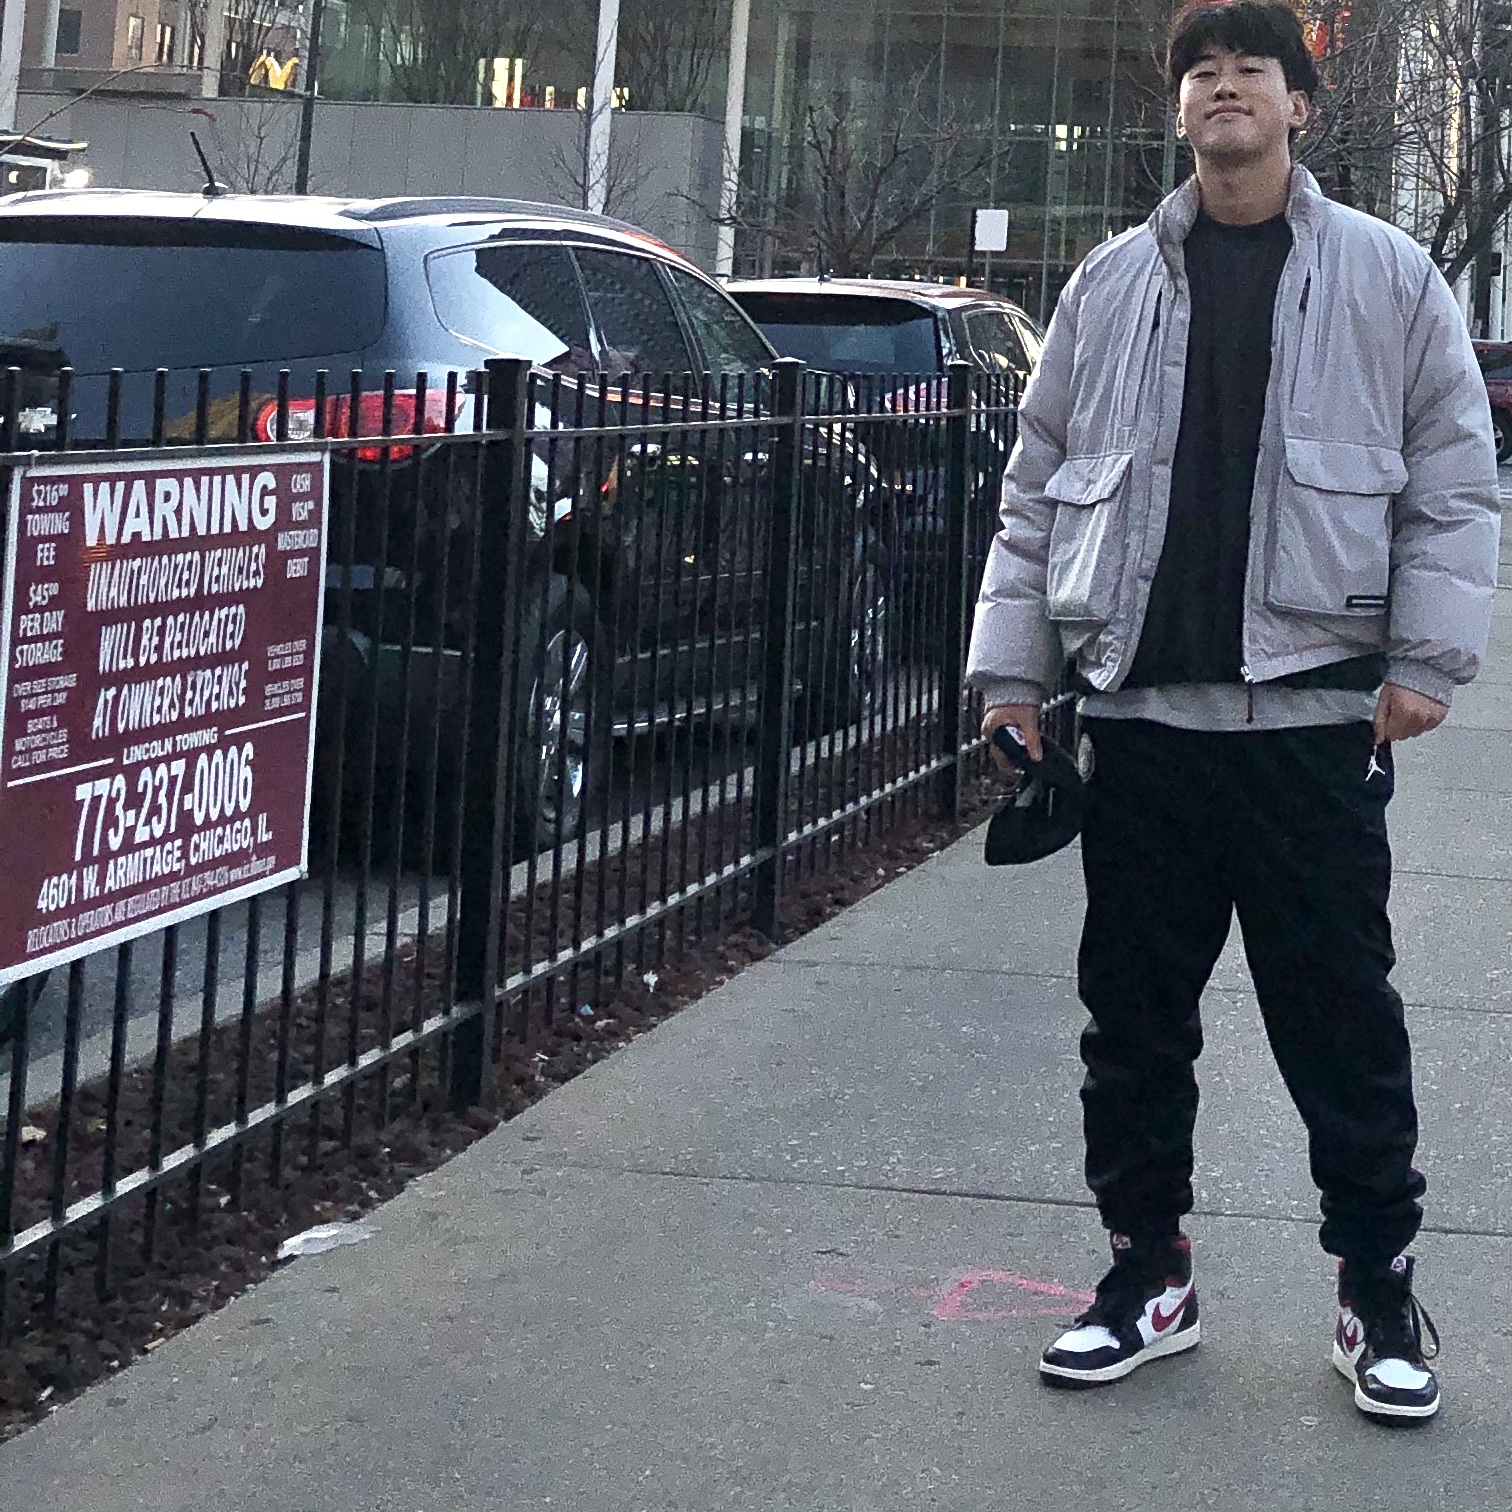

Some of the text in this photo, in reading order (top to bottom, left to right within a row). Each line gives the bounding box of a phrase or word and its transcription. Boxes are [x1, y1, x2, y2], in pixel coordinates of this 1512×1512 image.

[291, 472, 312, 493] CASH
[25, 511, 71, 537] TOWING
[83, 471, 277, 546] WARNING
[36, 542, 57, 566] FEE
[286, 557, 310, 579] DEBIT
[86, 543, 266, 613] UNAUTHORIZED VEHICLES
[19, 609, 65, 638] PER DAY
[98, 603, 246, 675] WILL BE RELOCATED
[14, 639, 65, 669] STORAGE
[91, 660, 249, 741] AT OWNERS EXPENSE
[11, 754, 31, 769] CALL
[122, 726, 219, 765] LINCOLN TOWING
[74, 741, 255, 862] 773-237-0006
[36, 812, 273, 914] 4601 W. ARMITAGE, CHICAGO, IL.
